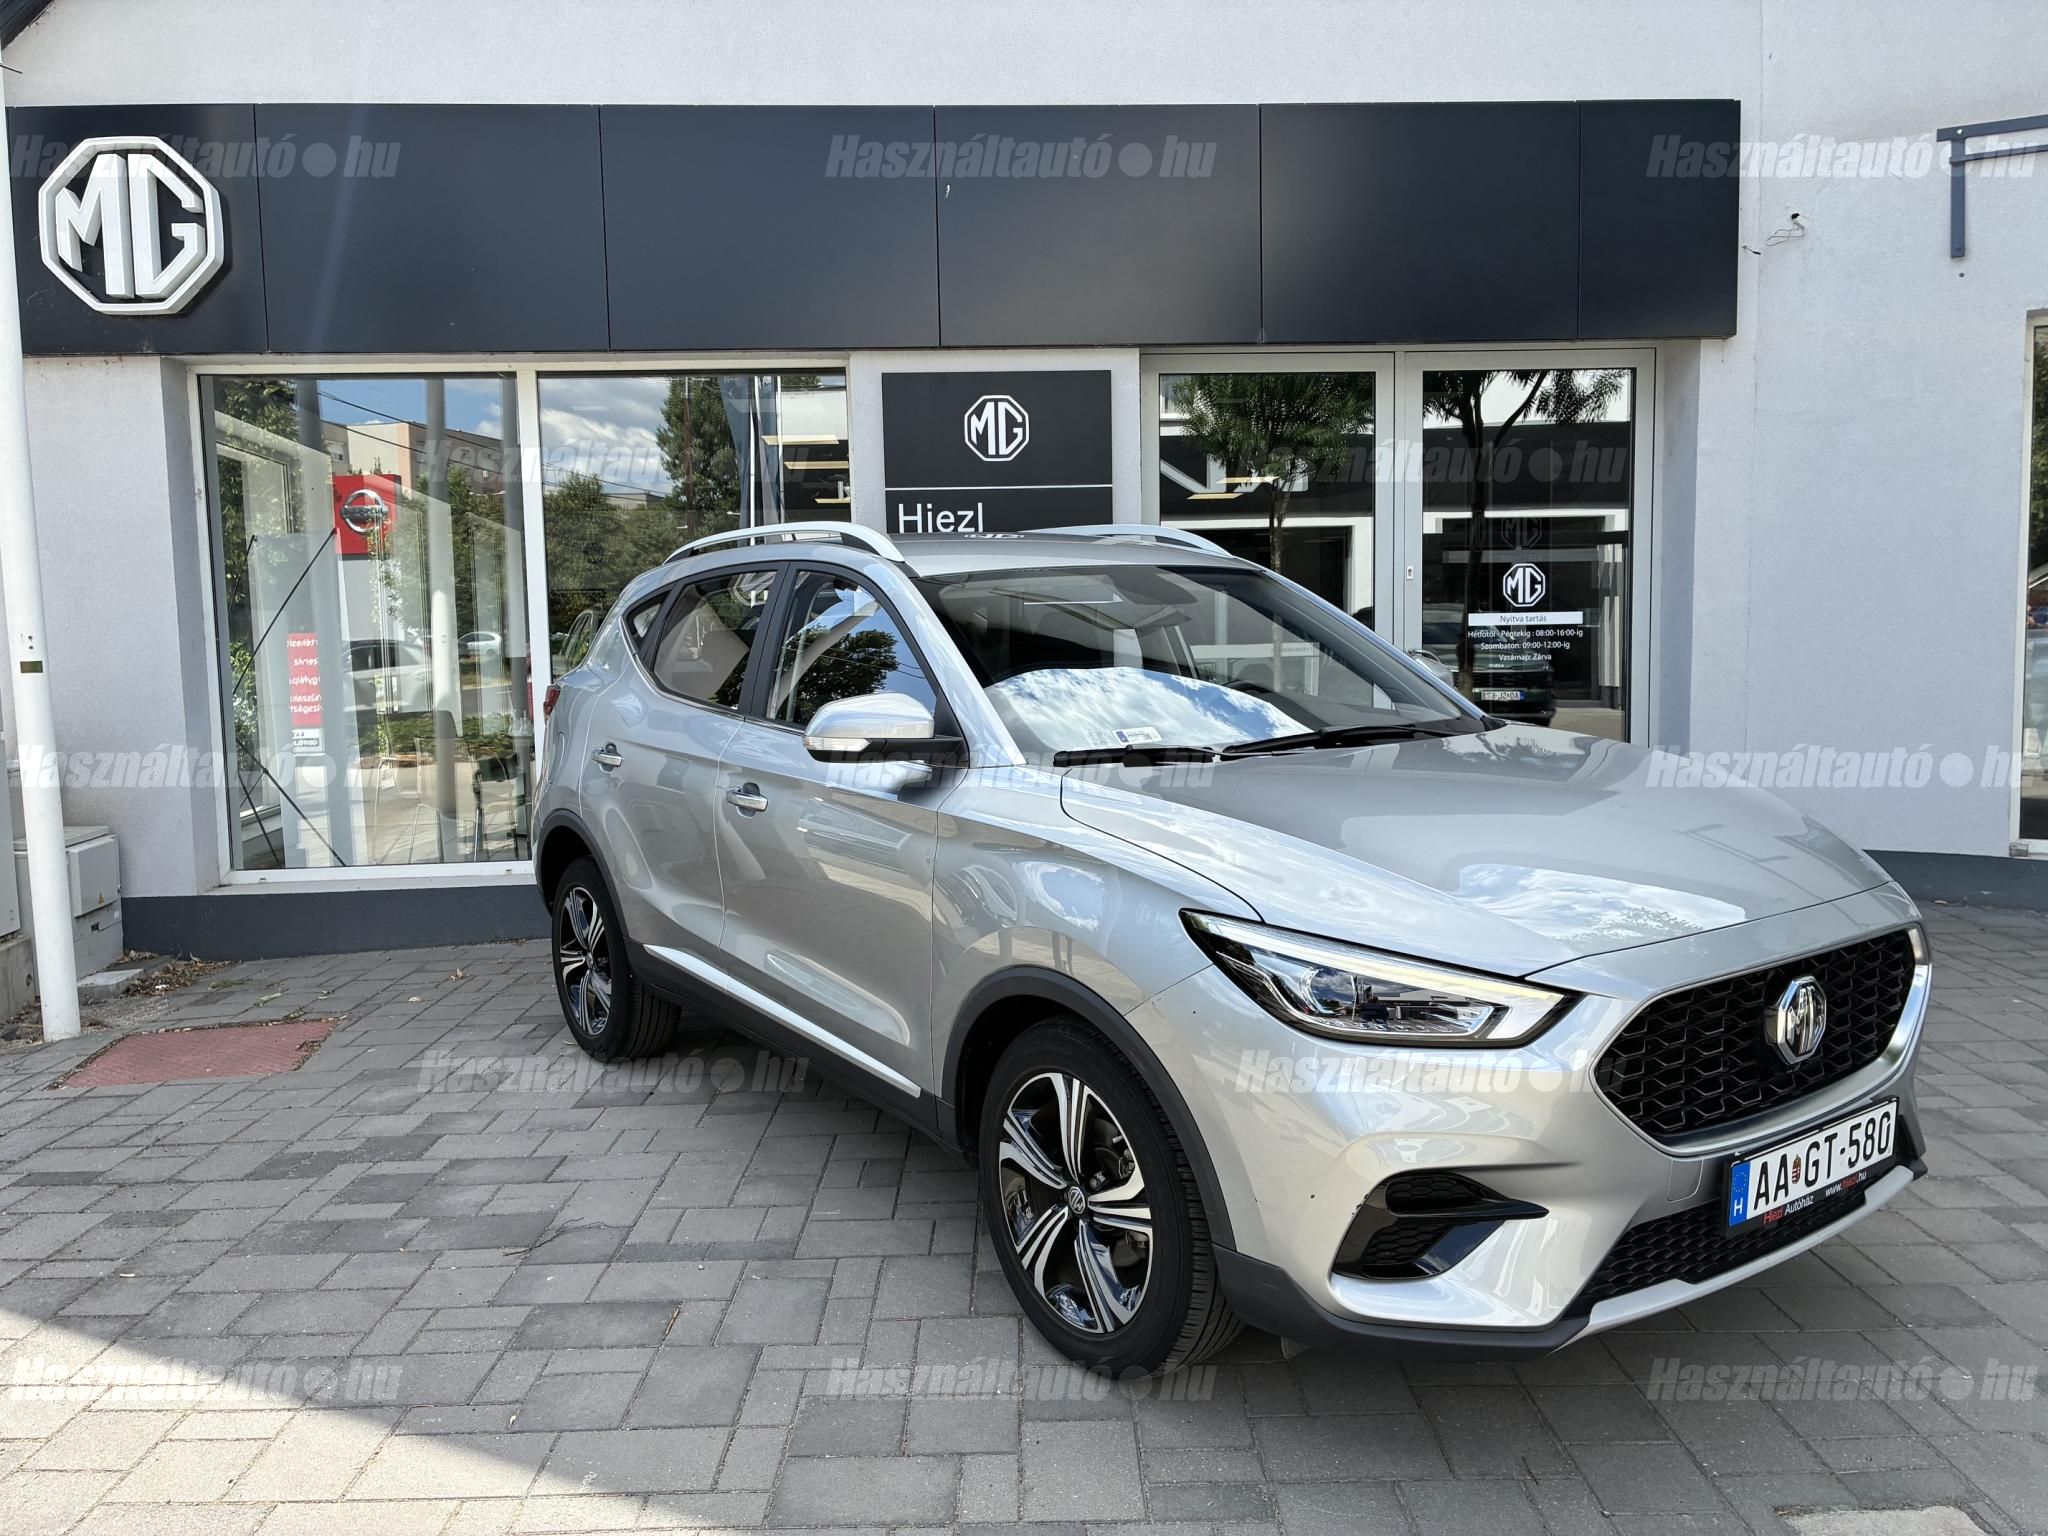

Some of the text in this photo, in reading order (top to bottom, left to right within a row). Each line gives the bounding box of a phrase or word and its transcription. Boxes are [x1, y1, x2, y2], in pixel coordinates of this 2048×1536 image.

[54, 152, 207, 299] MG
[969, 400, 1024, 456] MG
[898, 502, 983, 533] Hiezl
[1506, 566, 1542, 604] MG
[1500, 614, 1548, 624] Nyitva tartás
[1533, 653, 1552, 661] Zárva
[1733, 1197, 1743, 1217] H
[1763, 1205, 1784, 1225] Hiezl
[1784, 1194, 1815, 1216] Autóház
